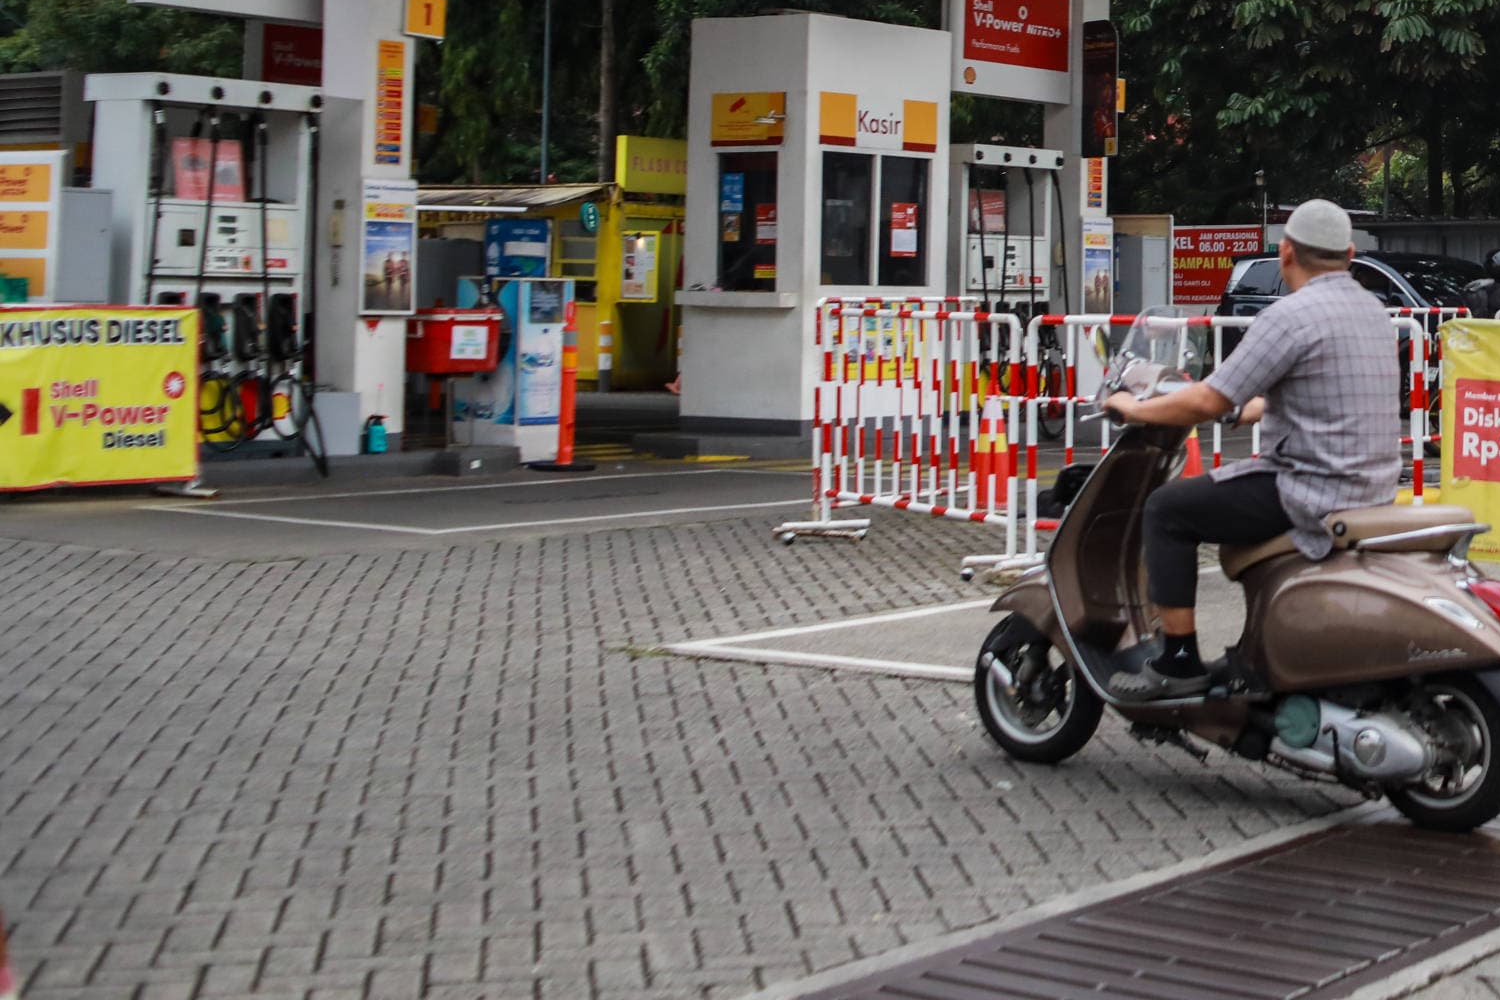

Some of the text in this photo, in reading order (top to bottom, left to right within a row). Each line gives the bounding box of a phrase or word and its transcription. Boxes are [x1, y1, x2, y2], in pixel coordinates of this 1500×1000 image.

[423, 3, 432, 26] 1
[973, 0, 994, 12] Shell
[974, 12, 1024, 33] V-Power
[857, 110, 902, 135] Kasir
[1233, 241, 1259, 253] 22.00
[1173, 256, 1215, 269] SAMPAI
[0, 318, 186, 348] KHUSUS DIESEL
[51, 379, 99, 399] Shell
[50, 403, 170, 428] V-Power
[102, 429, 166, 449] Diesel
